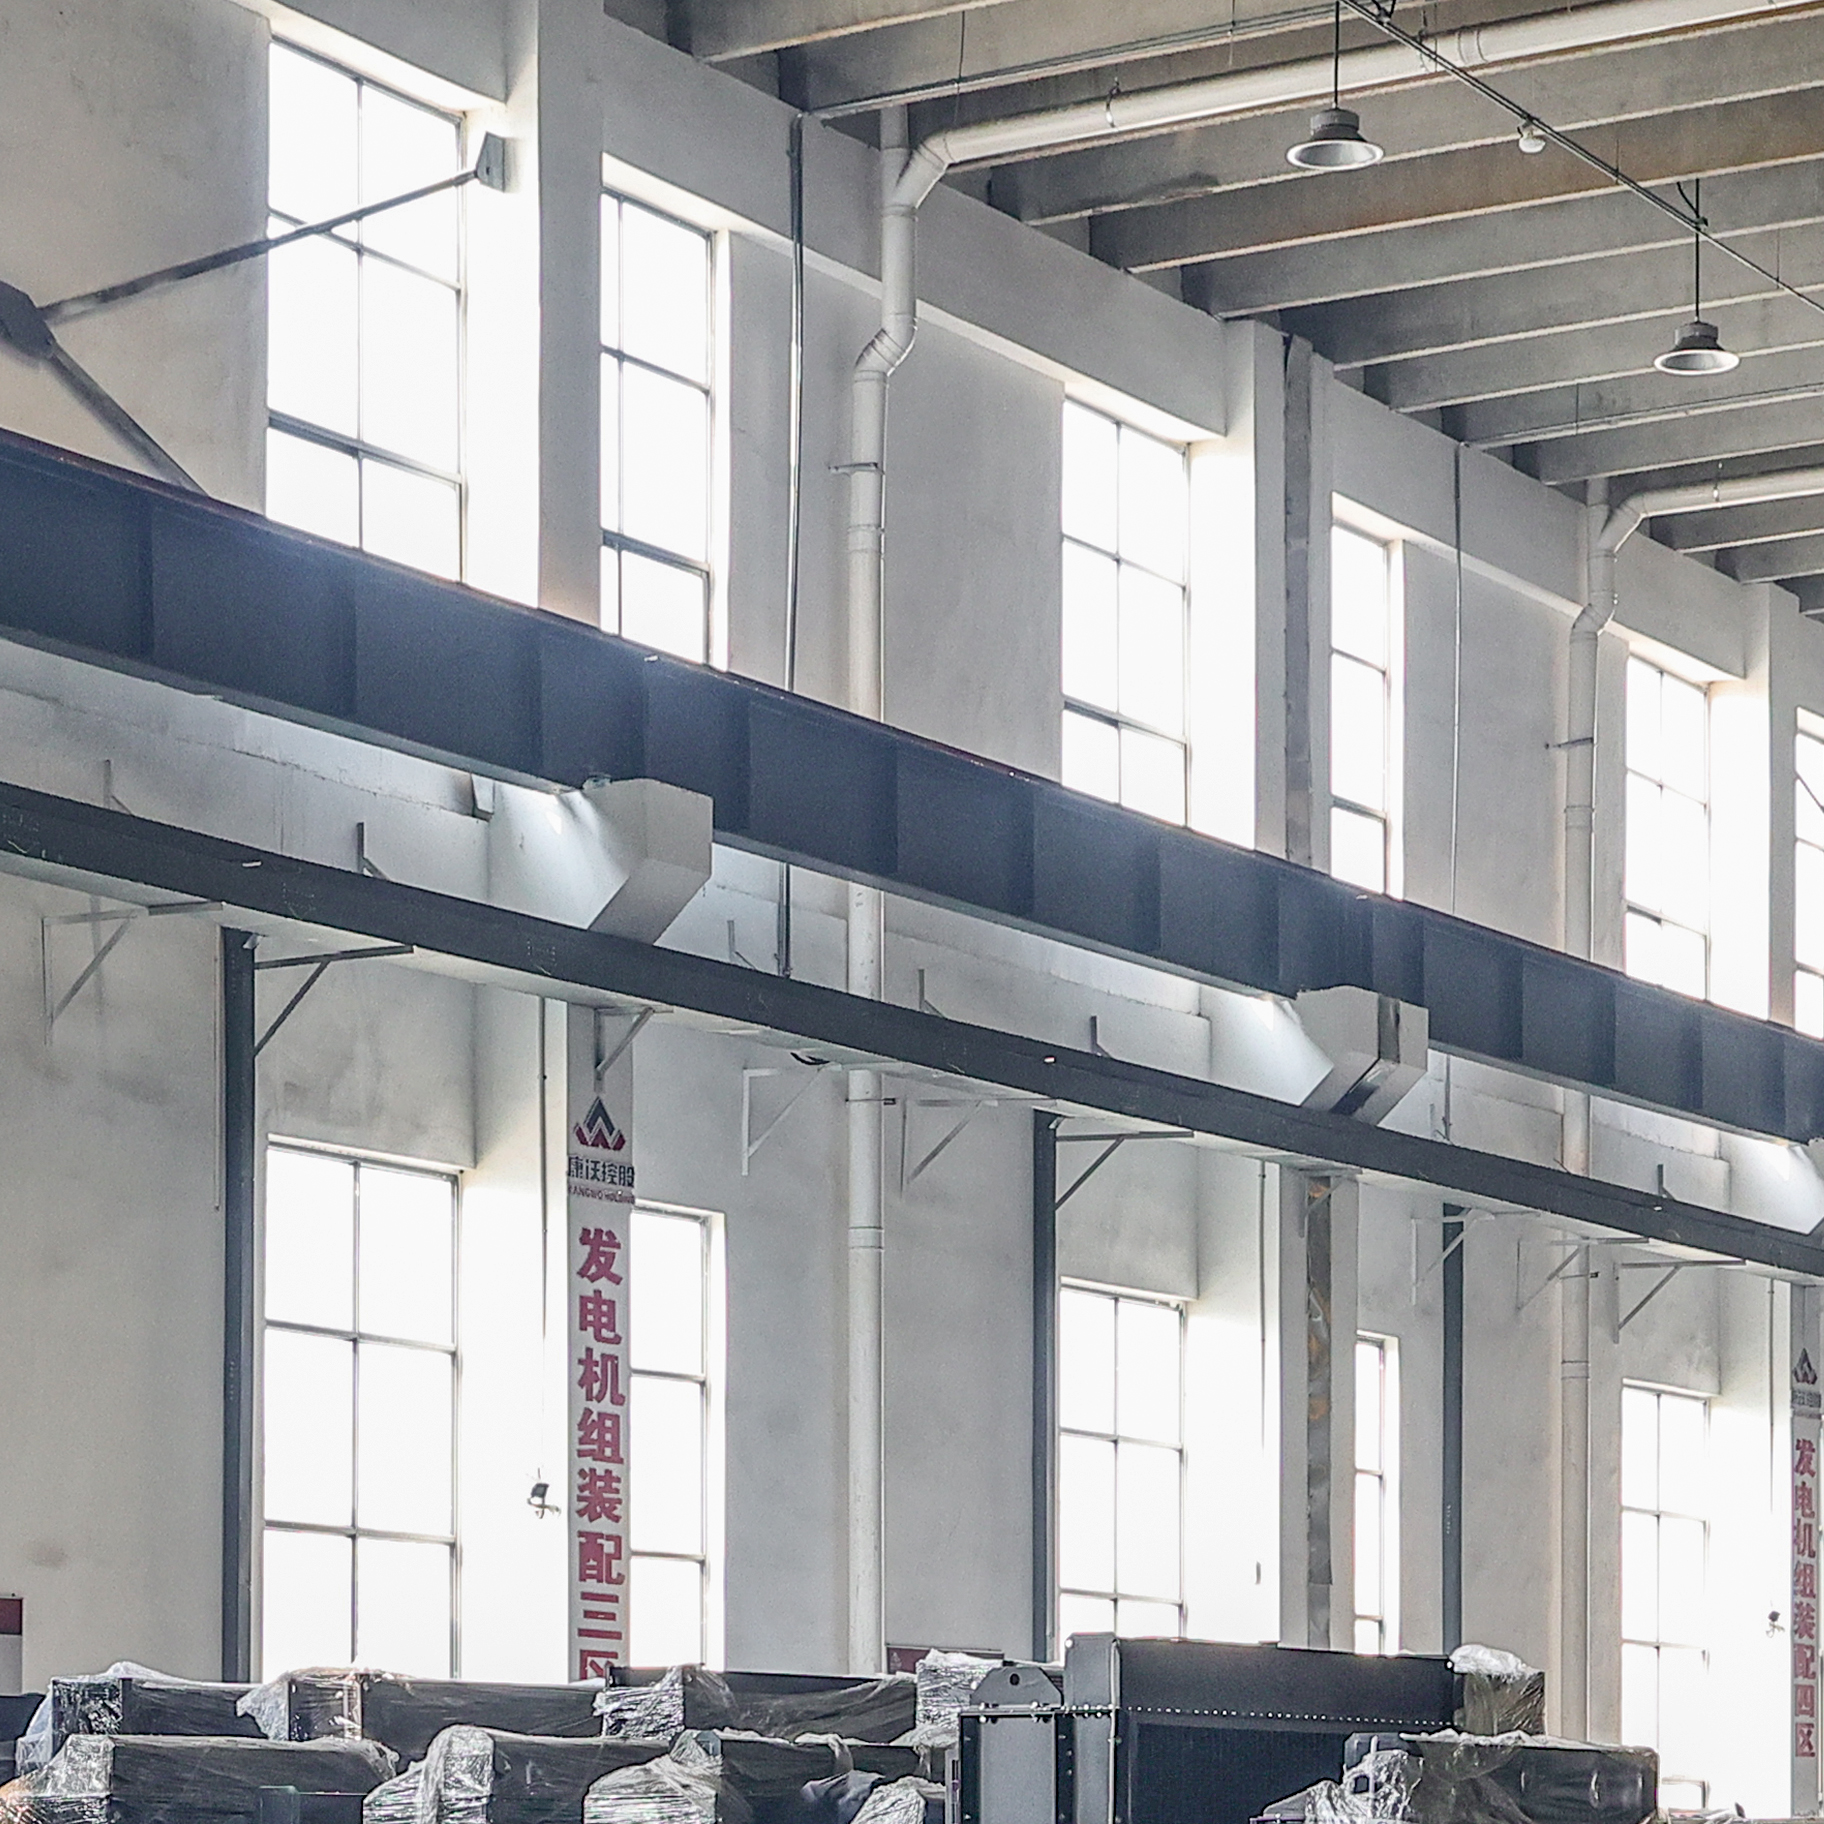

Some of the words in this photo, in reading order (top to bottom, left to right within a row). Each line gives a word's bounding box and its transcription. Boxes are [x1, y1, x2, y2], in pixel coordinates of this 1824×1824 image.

[1793, 1438, 1818, 1758] 发电机组装配四区
